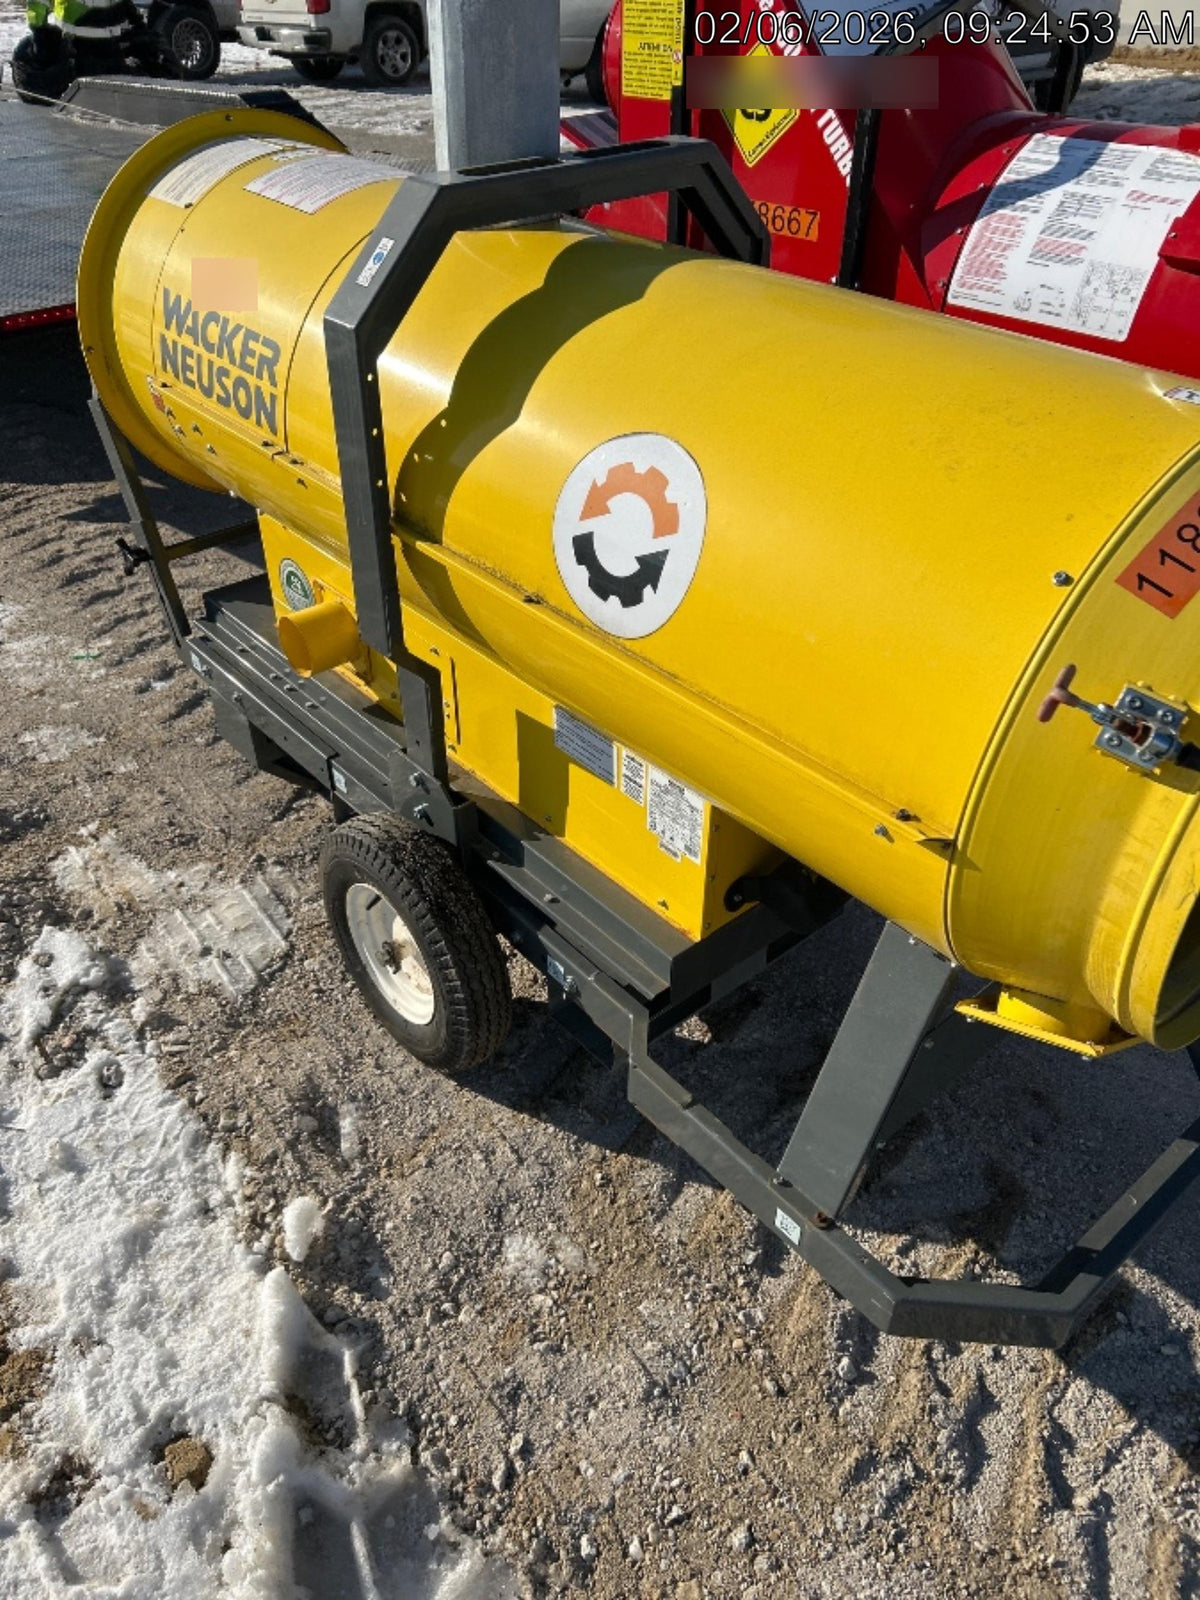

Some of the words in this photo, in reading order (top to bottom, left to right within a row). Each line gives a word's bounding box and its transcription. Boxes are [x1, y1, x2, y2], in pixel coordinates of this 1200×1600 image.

[817, 109, 854, 187] TURB
[160, 333, 278, 436] NEUSON
[163, 286, 281, 388] WACKER
[1136, 504, 1200, 598] 118
